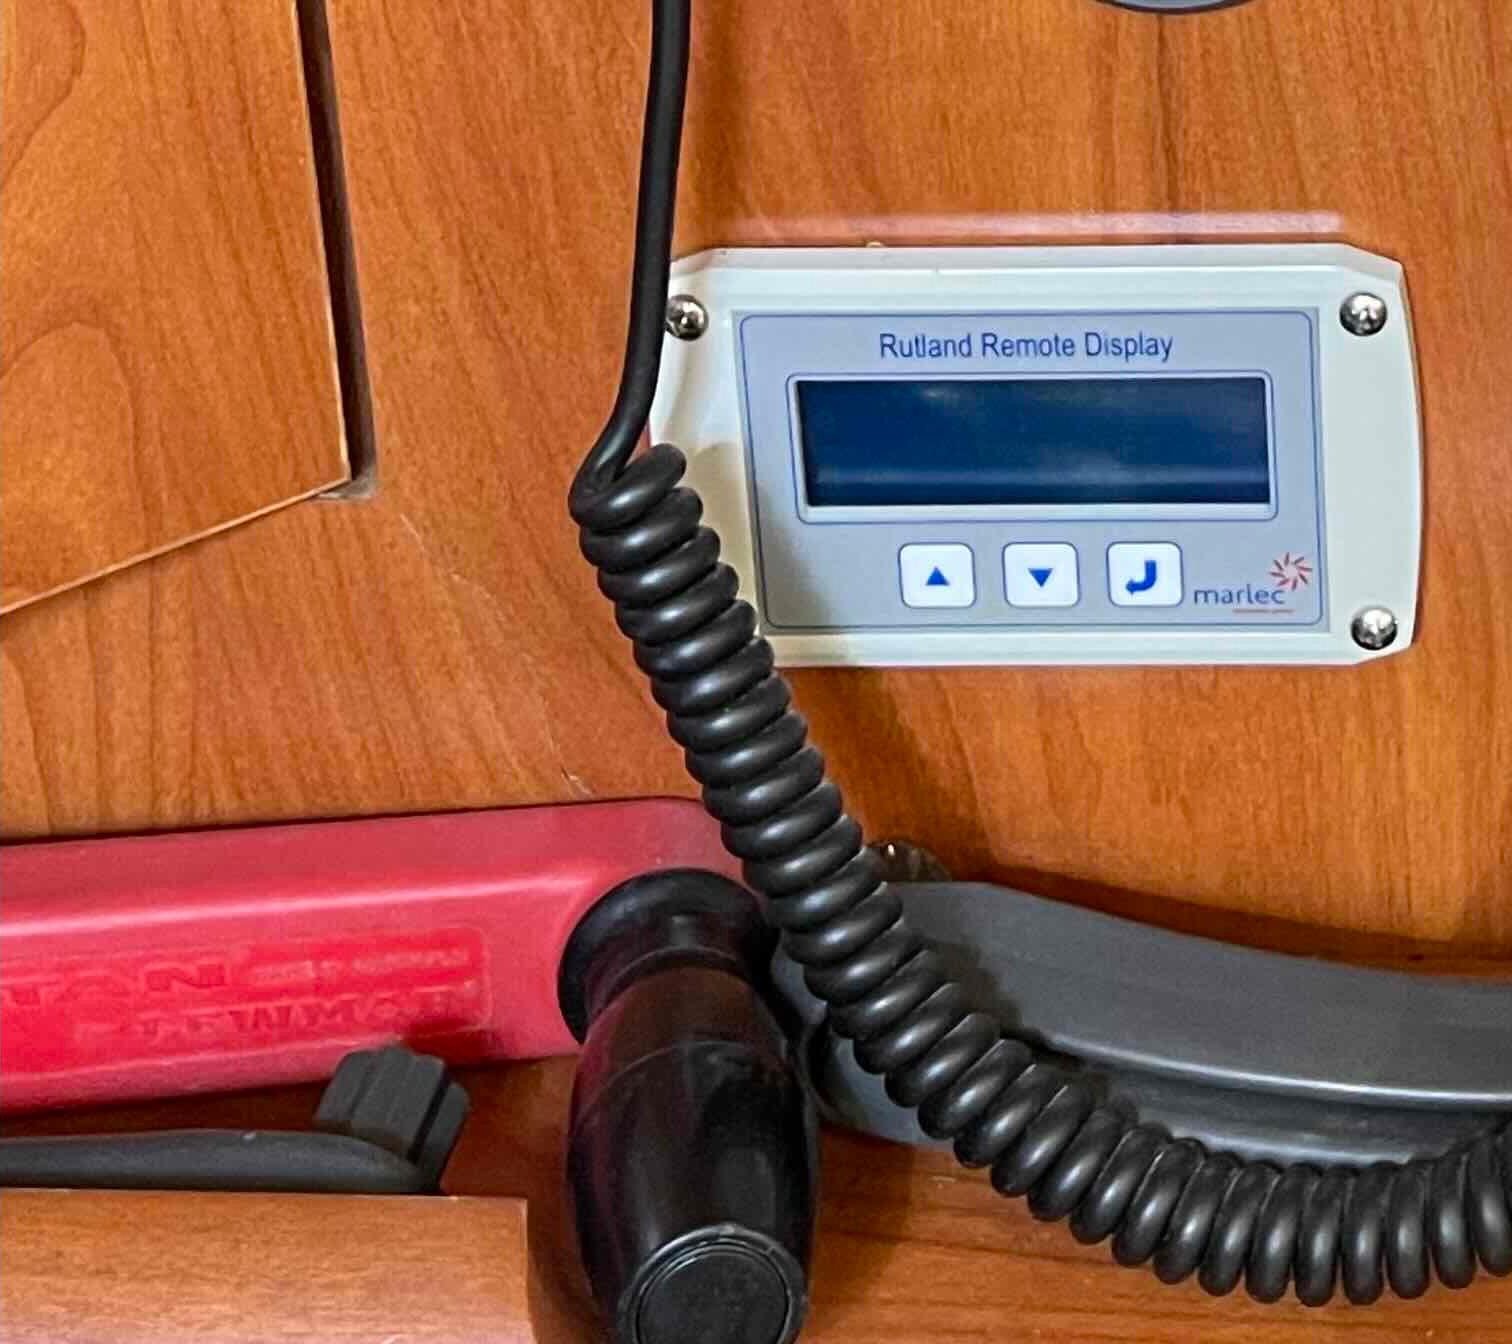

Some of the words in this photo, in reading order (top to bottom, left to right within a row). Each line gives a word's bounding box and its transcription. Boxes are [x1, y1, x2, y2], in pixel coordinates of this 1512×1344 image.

[880, 332, 972, 360] Rutland
[982, 333, 1075, 360] Remote
[1084, 333, 1173, 364] Display
[1194, 584, 1285, 604] marlec
